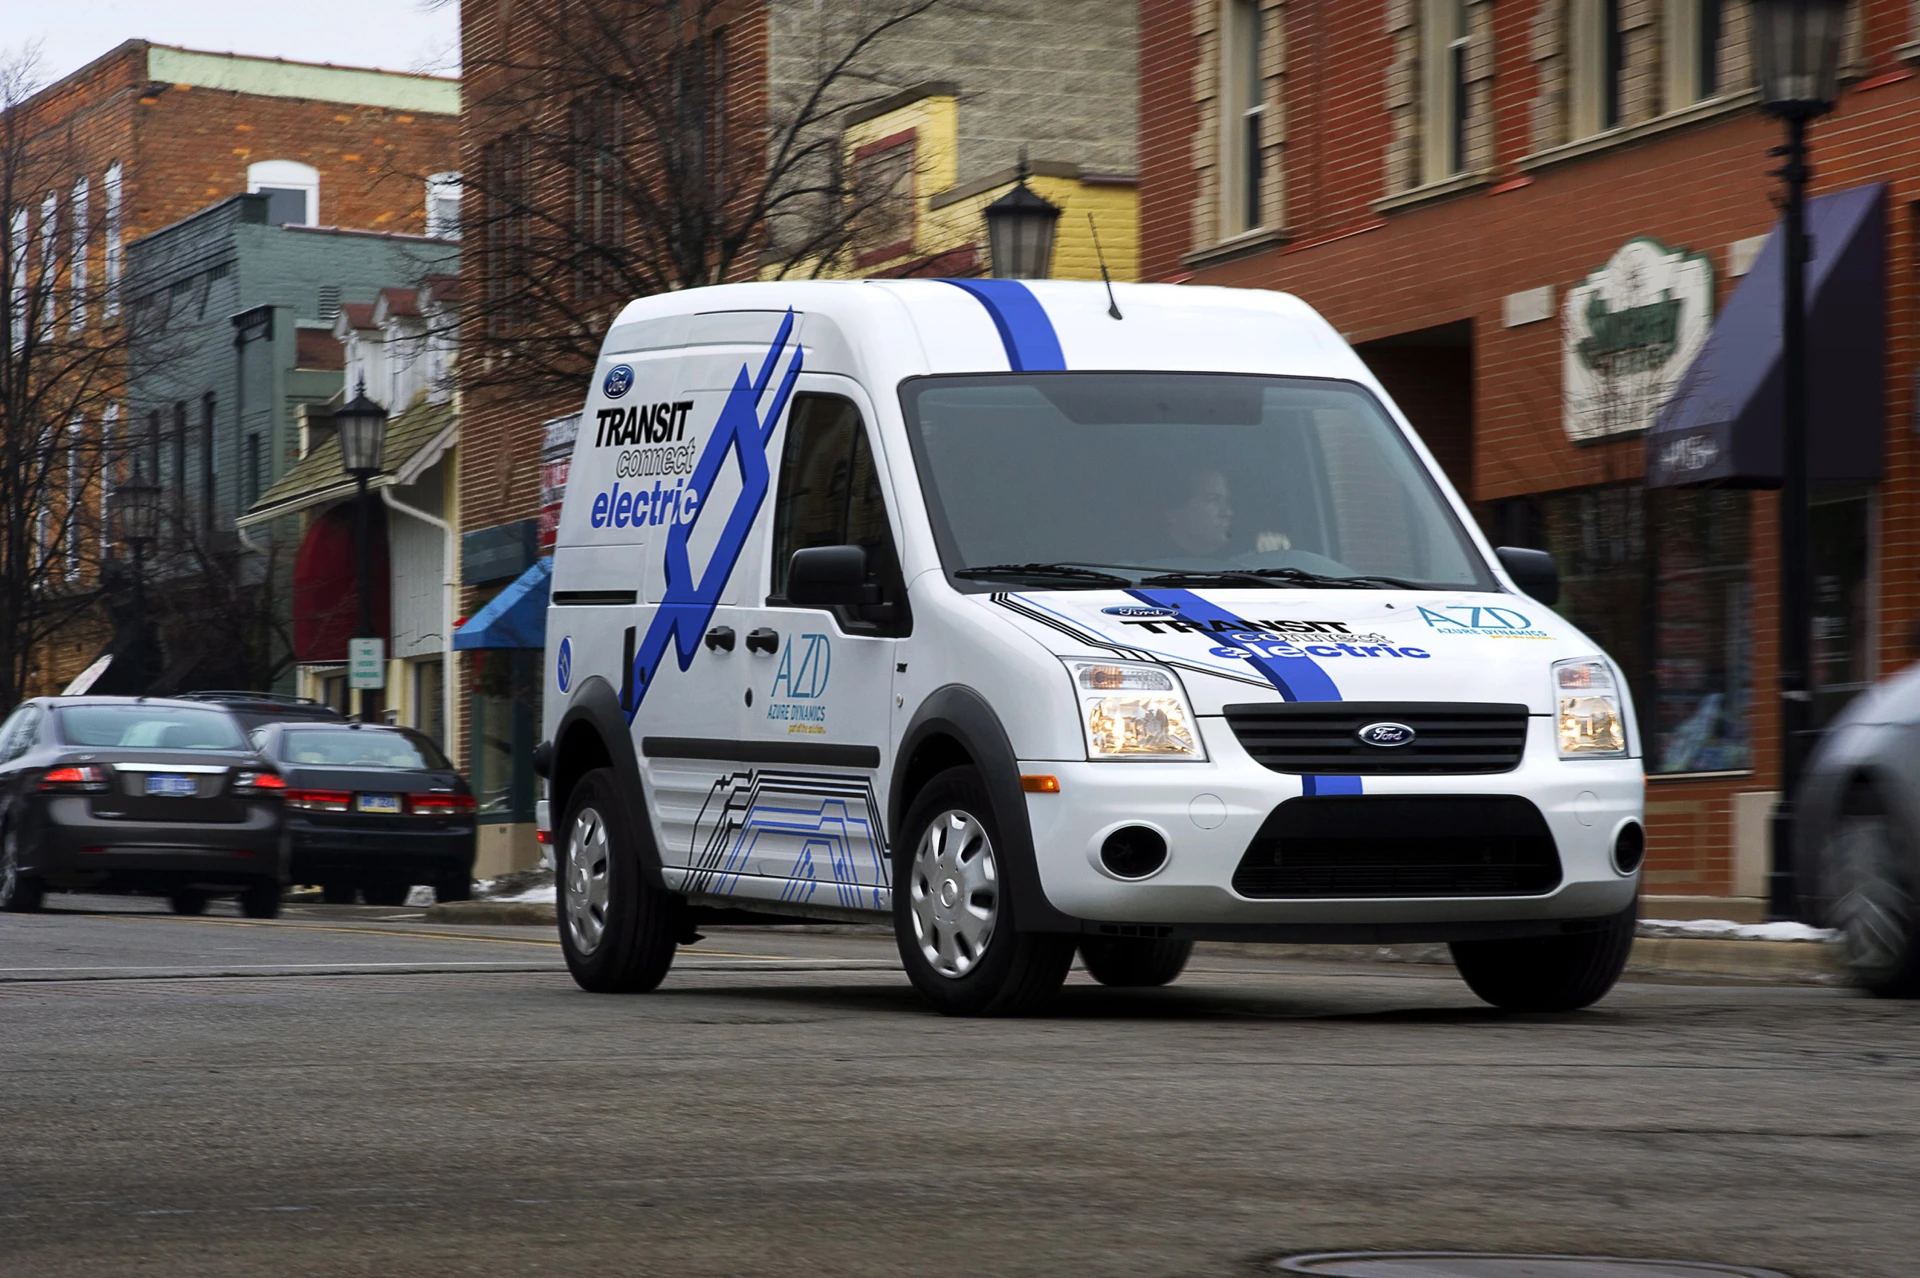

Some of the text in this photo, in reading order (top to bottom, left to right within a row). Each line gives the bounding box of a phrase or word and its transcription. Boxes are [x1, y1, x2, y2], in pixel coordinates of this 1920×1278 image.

[595, 400, 694, 448] TRANSIT
[616, 437, 696, 478] connect
[590, 478, 699, 529] electric
[1120, 620, 1352, 633] TRANSIT
[1416, 605, 1532, 629] AZD
[1231, 633, 1394, 644] connect
[1481, 629, 1547, 637] DYNAMICS
[1208, 642, 1431, 659] electric
[771, 633, 831, 699] AZD
[767, 703, 826, 722] AZURE DYNAMICS
[1372, 727, 1403, 741] Ford
